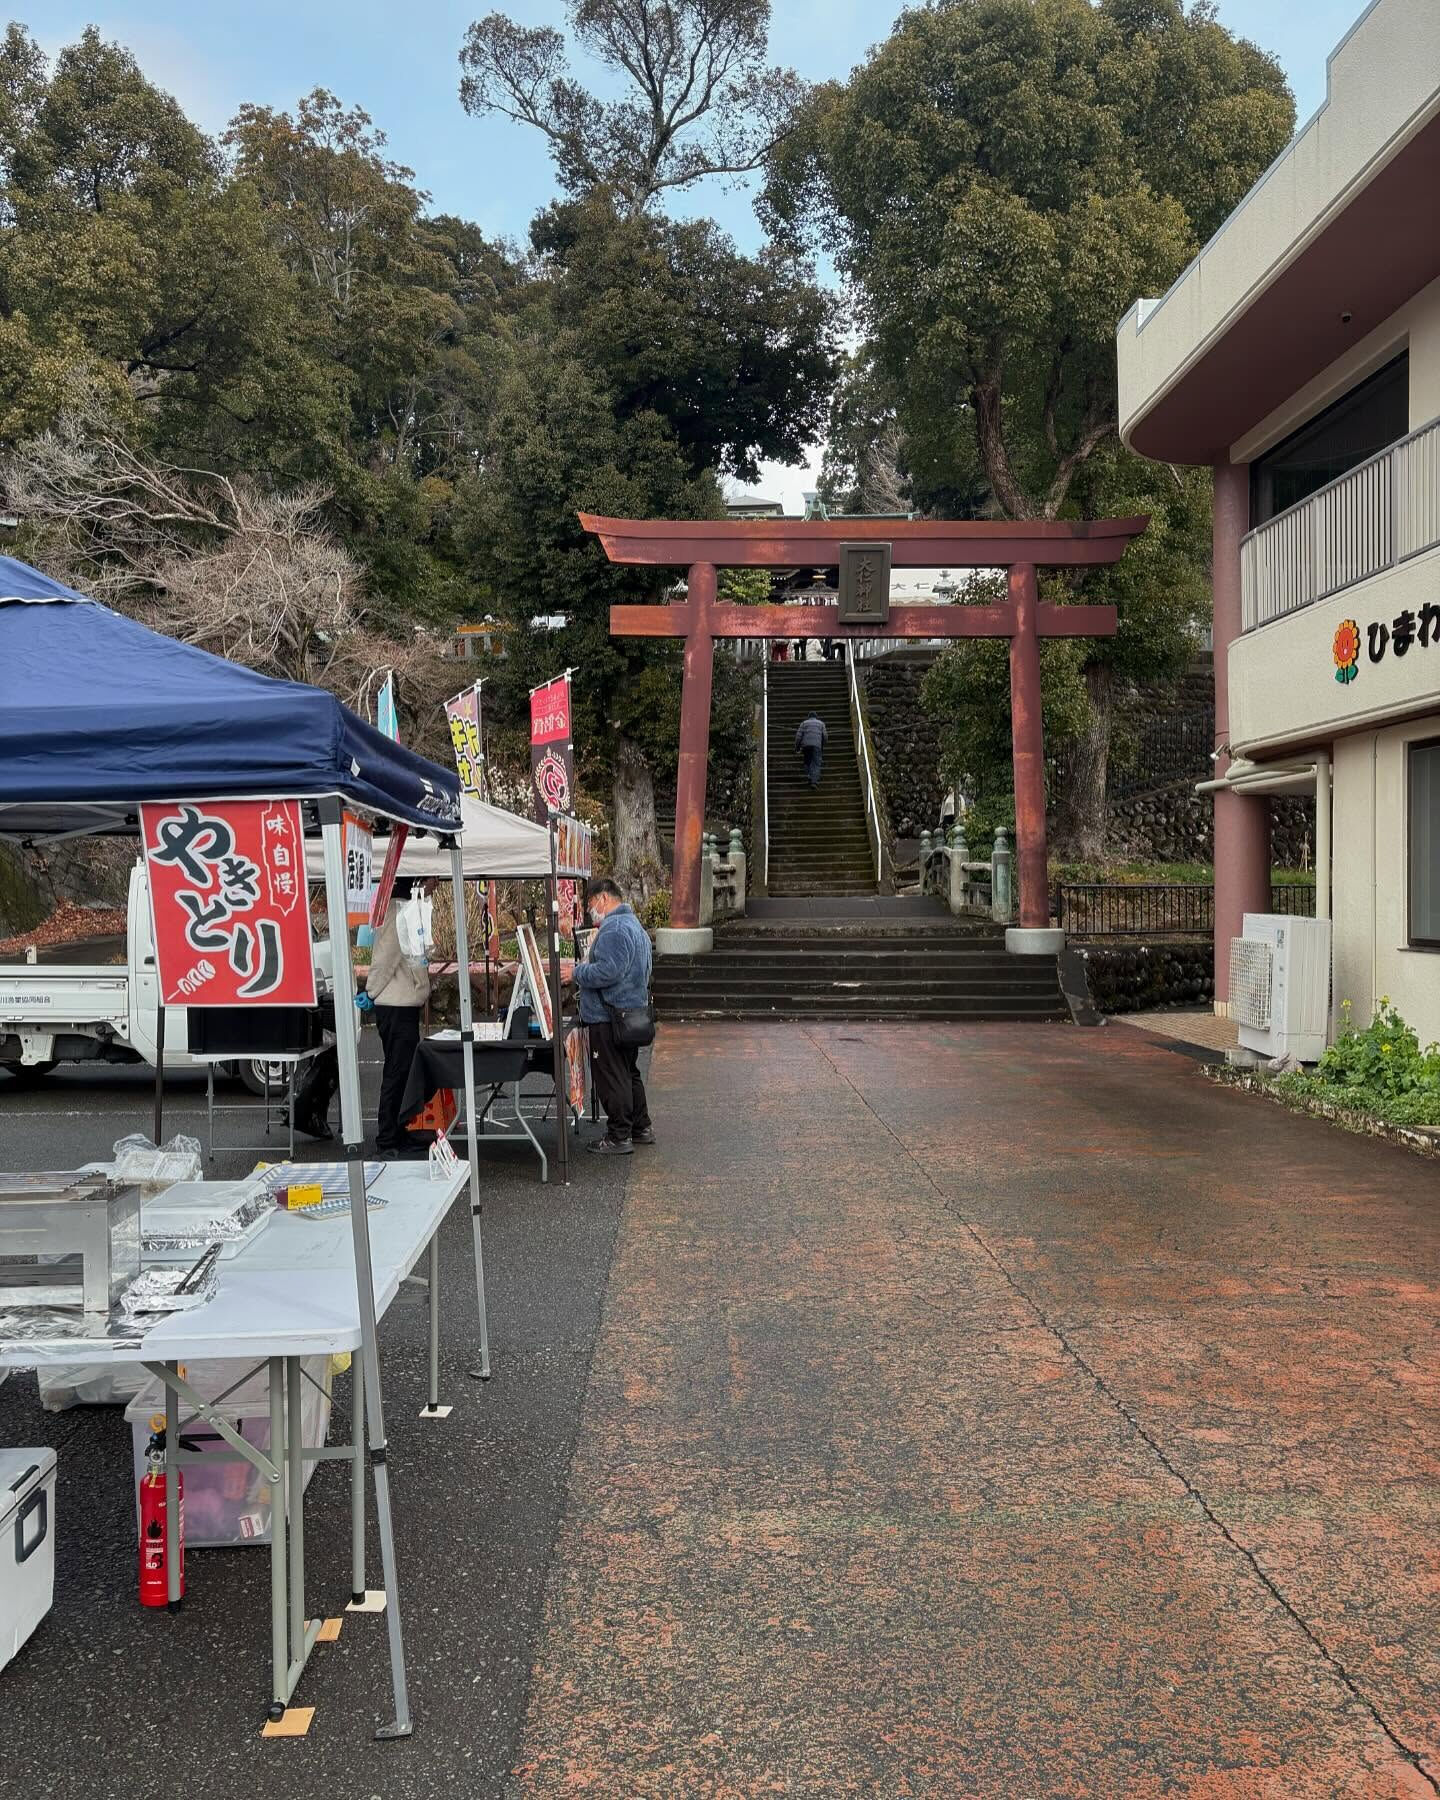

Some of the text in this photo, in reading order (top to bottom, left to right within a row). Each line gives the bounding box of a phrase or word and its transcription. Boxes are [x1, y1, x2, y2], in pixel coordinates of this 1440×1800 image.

[855, 556, 877, 613] 大仁神社
[1367, 602, 1440, 664] ひまわ
[266, 814, 295, 895] 味自慢
[148, 803, 283, 998] やきとり
